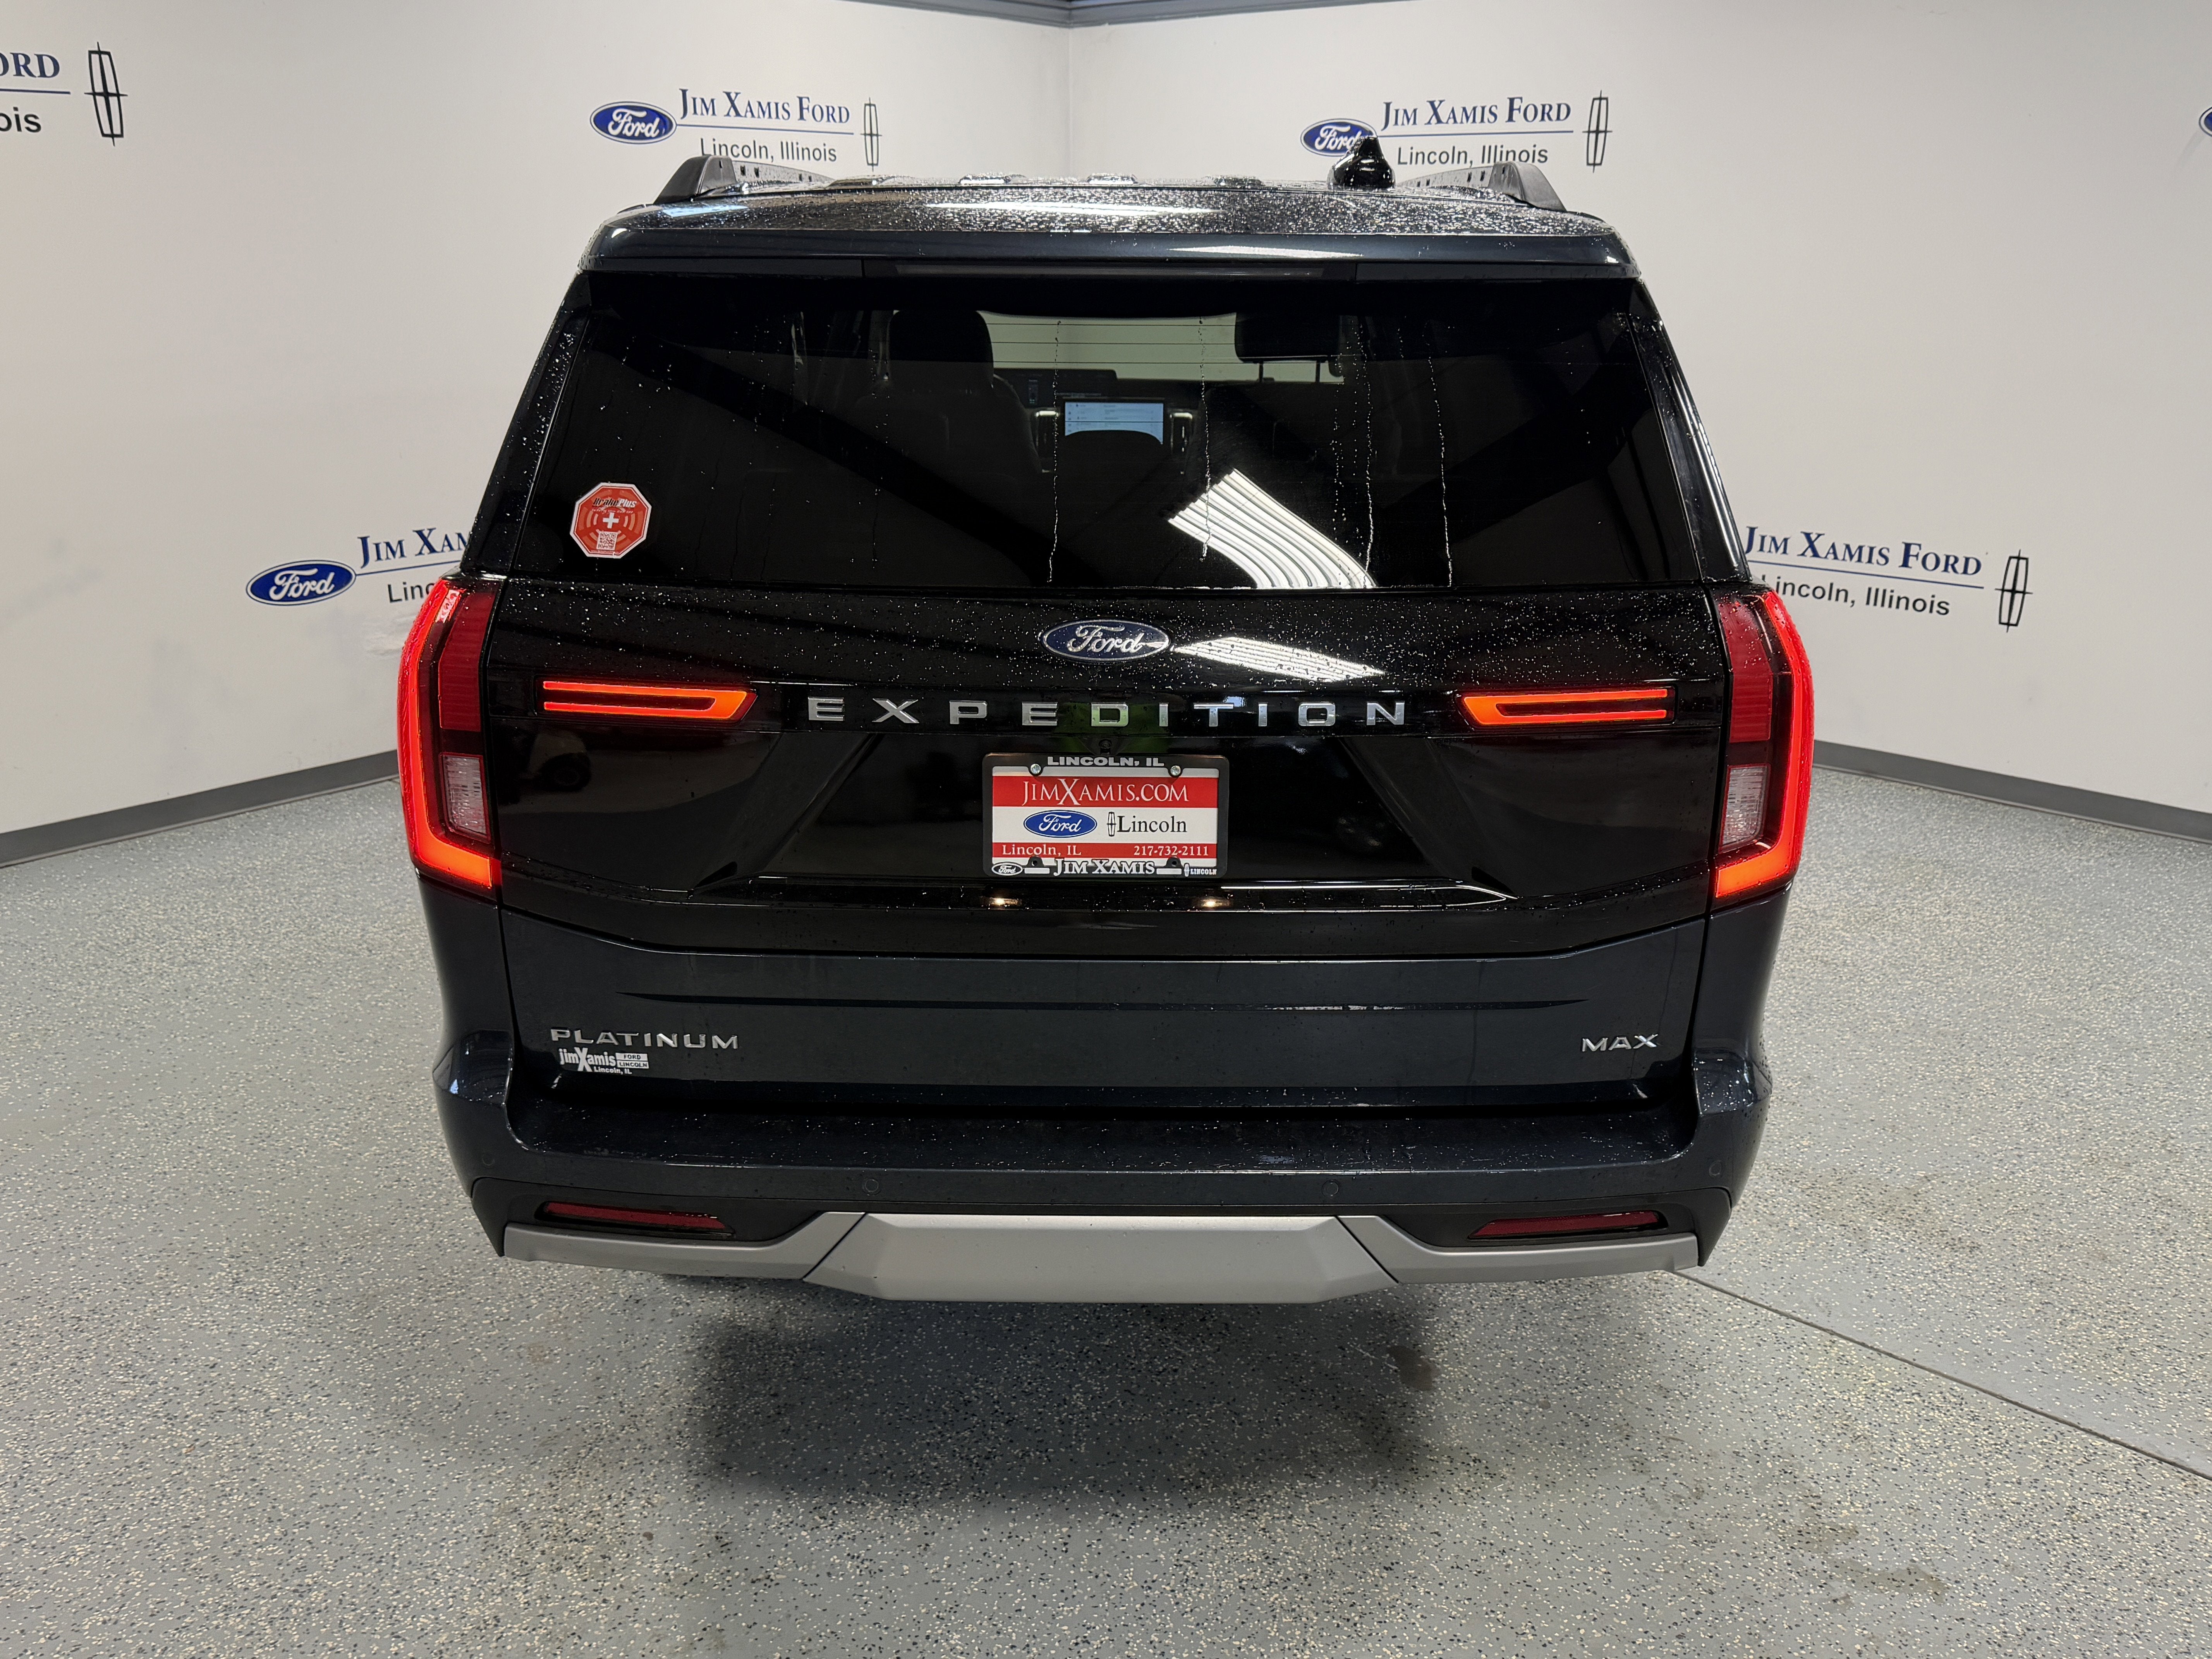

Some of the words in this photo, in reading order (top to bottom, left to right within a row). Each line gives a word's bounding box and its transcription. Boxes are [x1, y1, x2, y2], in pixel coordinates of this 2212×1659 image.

[679, 89, 716, 120] JIM
[723, 91, 790, 121] XAMIS
[796, 96, 850, 124] FORD
[1381, 101, 1418, 131] JIM
[1425, 99, 1498, 125] XAMIS
[1506, 96, 1571, 123] FORD
[608, 108, 660, 137] Ford
[1315, 125, 1362, 150] Ford
[701, 138, 774, 162] Lincoln,
[781, 141, 837, 162] Illinois
[1398, 146, 1473, 167] Lincoln,
[1481, 144, 1548, 164] Illinois
[357, 536, 407, 568] JIM
[1745, 526, 1791, 555] JIM
[1796, 531, 1890, 566] XAMIS
[1898, 541, 1982, 576] FORD
[270, 568, 335, 600] Ford
[1762, 574, 1856, 608] incoln,
[1865, 586, 1951, 616] Illinois
[1067, 625, 1144, 653] Ford
[807, 697, 1406, 728] EXPEDITION
[1048, 757, 1140, 767] LINCOLN,
[1146, 757, 1164, 767] IL
[1039, 814, 1081, 832] Ford
[1117, 816, 1187, 833] Lincoln
[1002, 844, 1061, 856] Lincoln,
[1067, 845, 1081, 855] IL
[1134, 846, 1208, 856] 217-732-2111
[998, 865, 1016, 873] Ford
[1053, 859, 1088, 876] JIM
[1092, 859, 1155, 874] XAMIS
[551, 1029, 738, 1049] PLATINUM
[1582, 1034, 1658, 1052] MAX
[594, 1066, 623, 1075] Lincoln,
